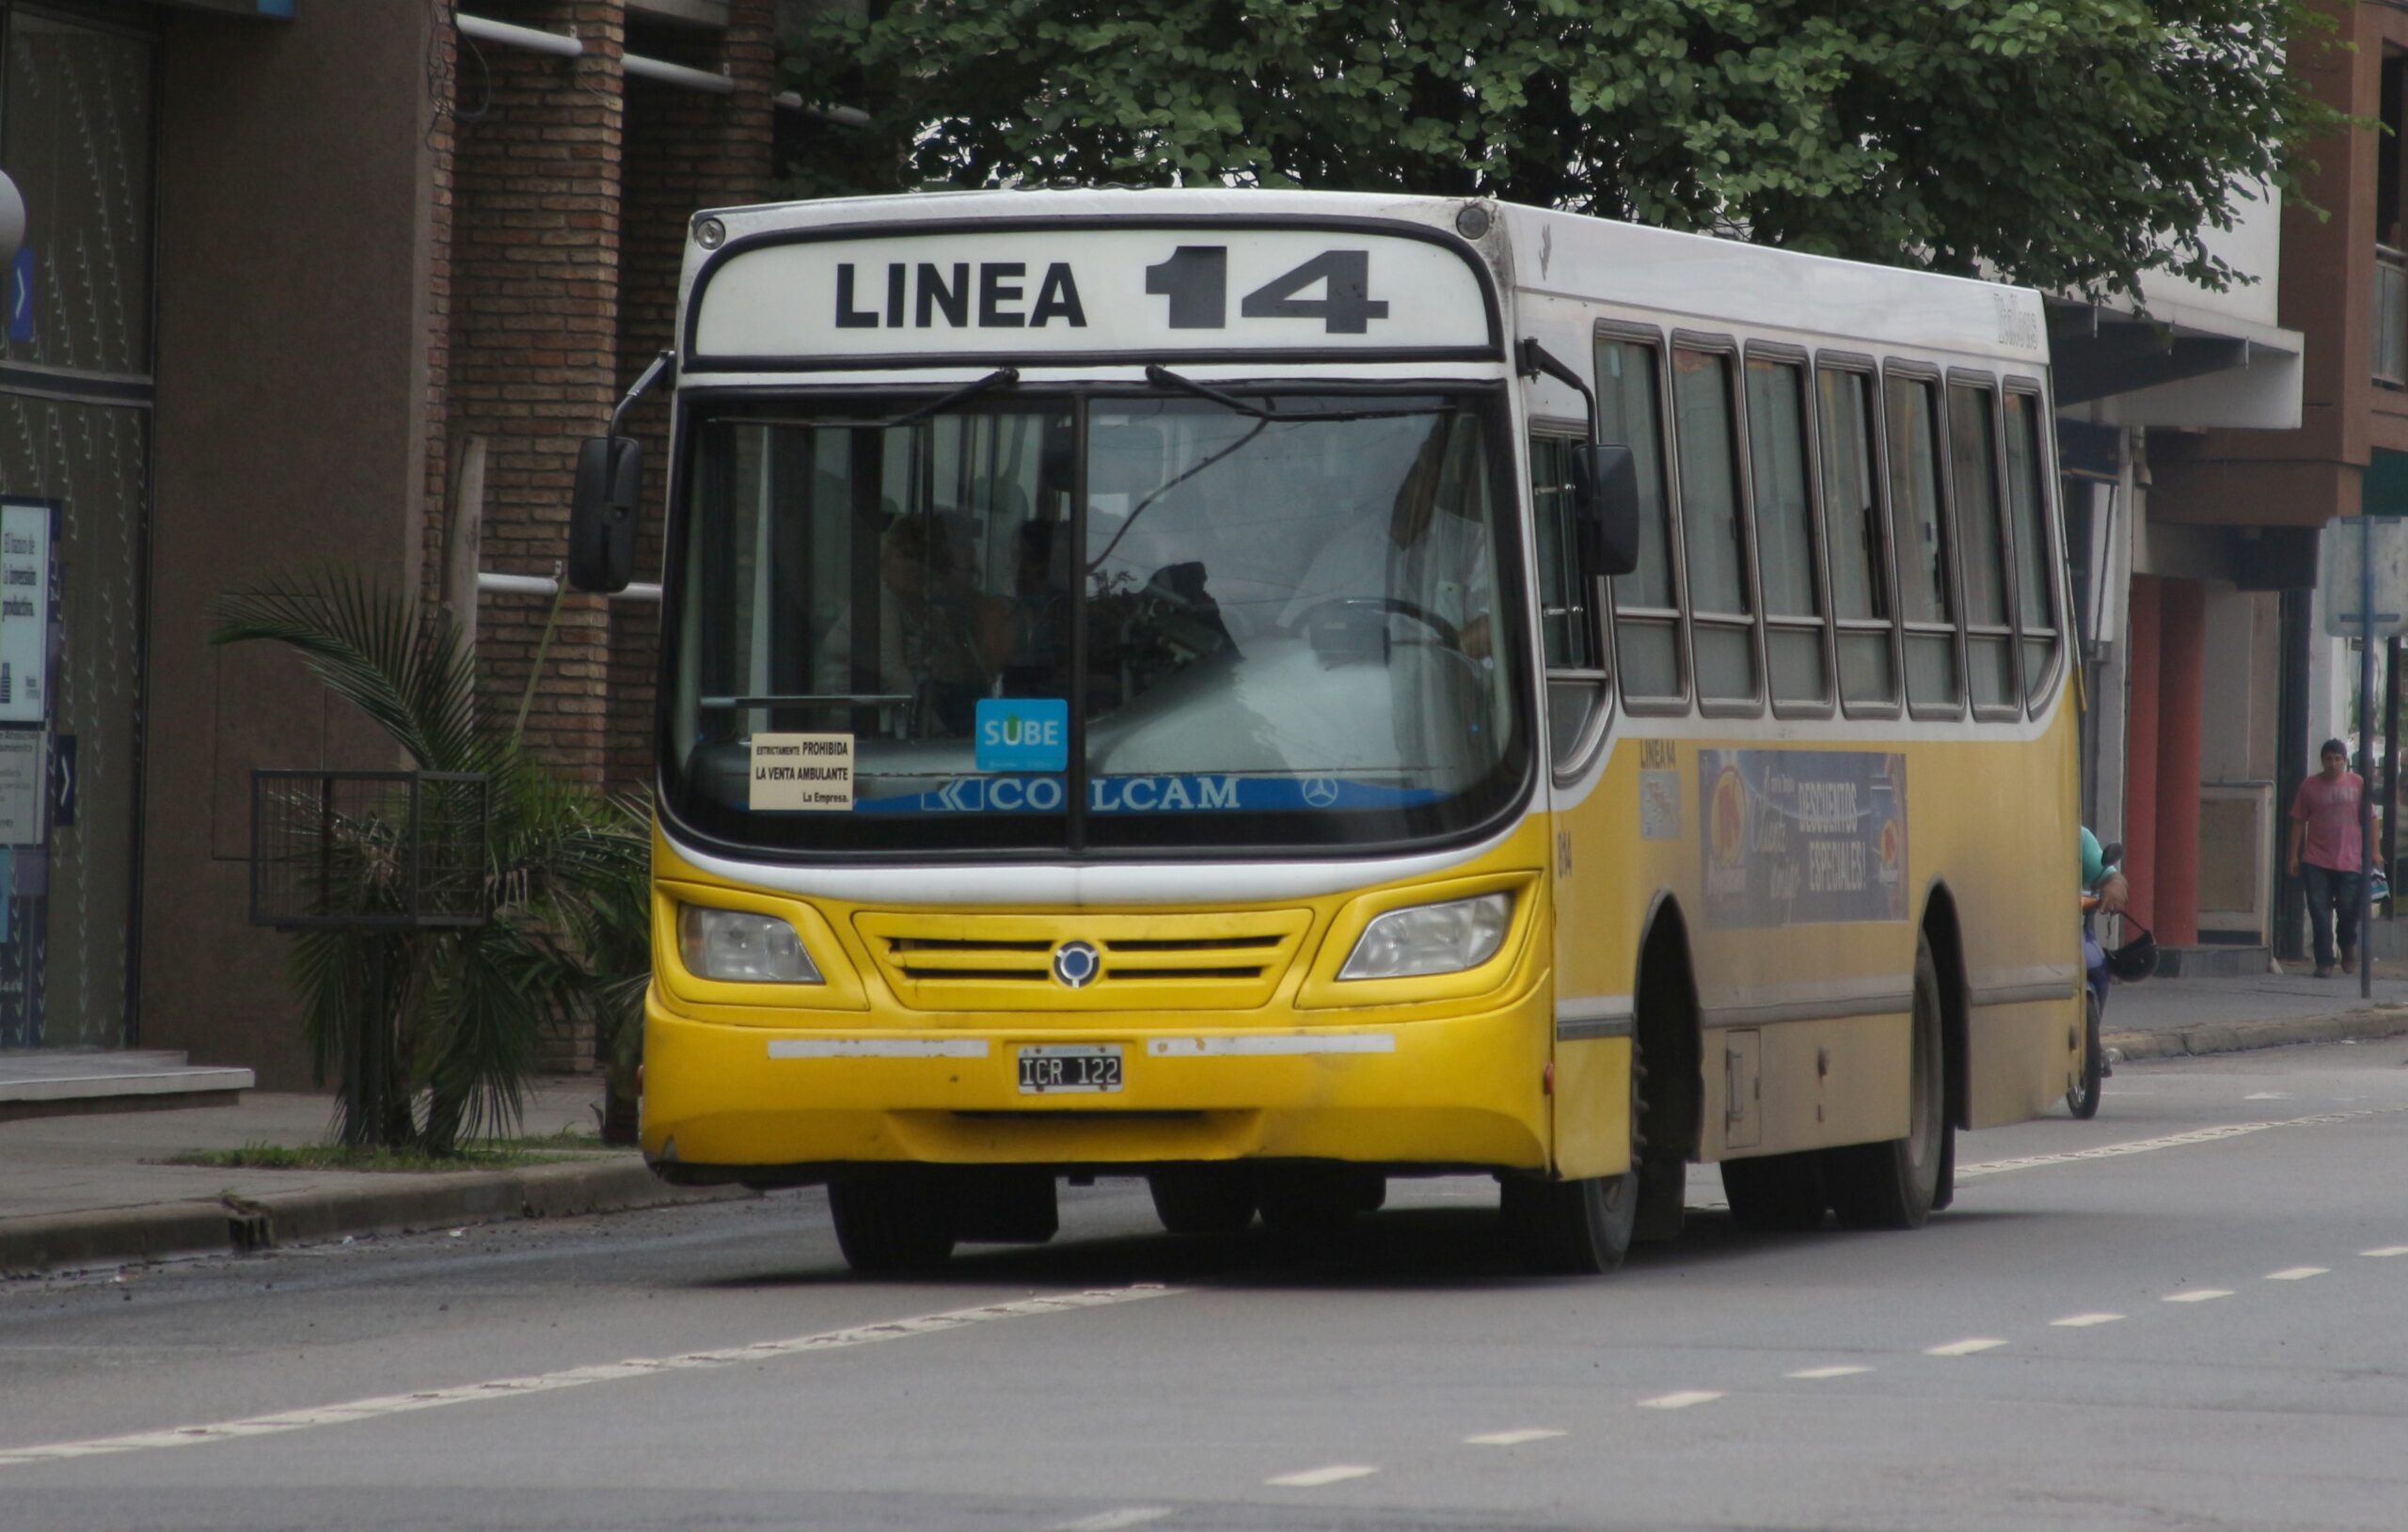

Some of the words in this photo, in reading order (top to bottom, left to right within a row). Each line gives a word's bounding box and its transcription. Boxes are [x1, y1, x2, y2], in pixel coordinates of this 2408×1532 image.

[835, 262, 1087, 328] LINEA
[1146, 245, 1389, 334] 14
[984, 718, 1059, 746] SUBE
[802, 741, 848, 756] PROHIBIDA
[1640, 738, 1666, 769] LINEA
[756, 766, 767, 781] LA
[768, 766, 796, 781] VENTA
[798, 767, 848, 782] AMBULANTE
[802, 792, 813, 803] La
[815, 792, 849, 806] Empresa.
[1798, 782, 1858, 833] DESCUENTOS
[1022, 1058, 1064, 1085] ICR
[1077, 1058, 1118, 1084] 122
